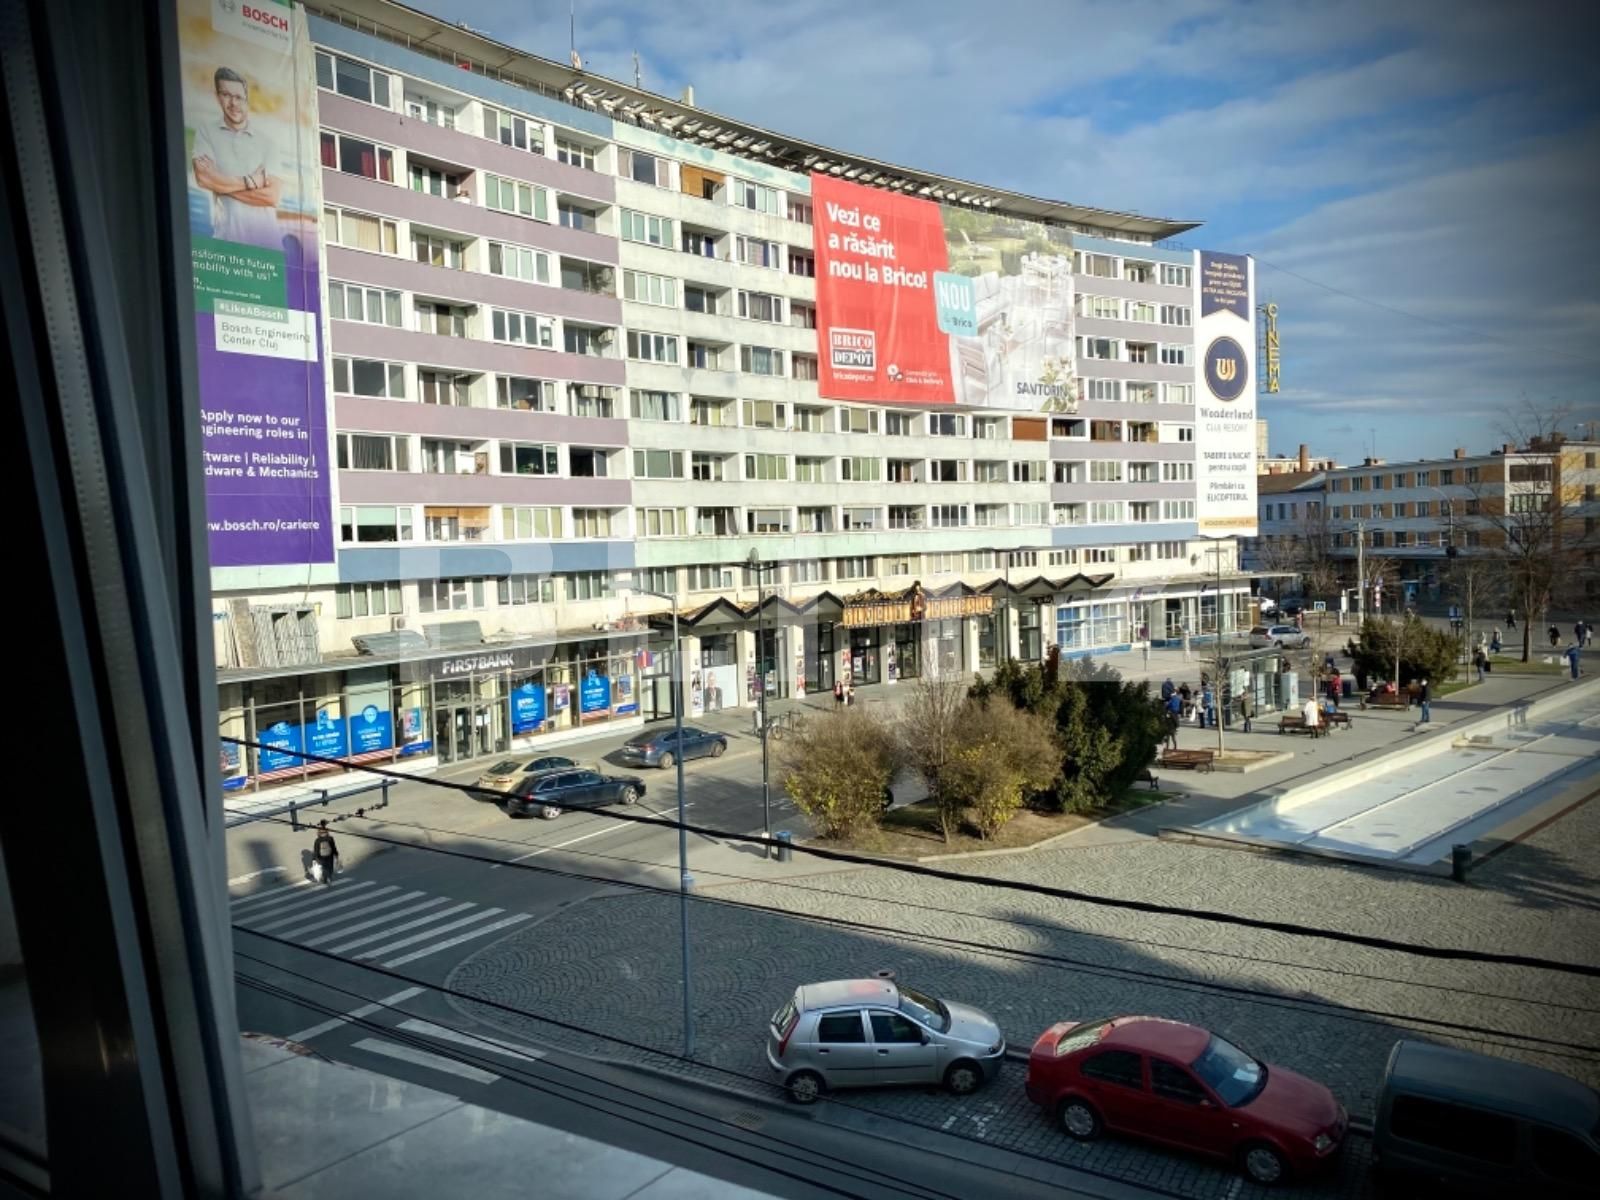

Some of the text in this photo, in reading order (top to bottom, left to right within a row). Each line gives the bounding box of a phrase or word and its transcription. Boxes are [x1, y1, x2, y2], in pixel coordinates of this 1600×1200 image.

[242, 4, 288, 32] BOSCH
[826, 201, 880, 232] Vezi ce
[828, 231, 896, 260] a răsărit
[229, 255, 246, 266] the
[247, 258, 275, 270] future
[233, 267, 253, 278] with
[829, 260, 928, 289] nou la Brico!
[938, 281, 971, 313] NOU
[219, 302, 283, 320] #LikeABosch
[221, 321, 310, 343] Bosch Engineering
[833, 333, 873, 349] BRICO
[223, 333, 278, 351] Center Cluj
[200, 408, 300, 427] Apply now to our
[1200, 407, 1254, 420] Wonderland
[266, 427, 294, 439] roles
[297, 427, 308, 439] in
[252, 453, 309, 469] Reliability
[247, 466, 257, 477] &
[259, 466, 320, 479] Mechanics
